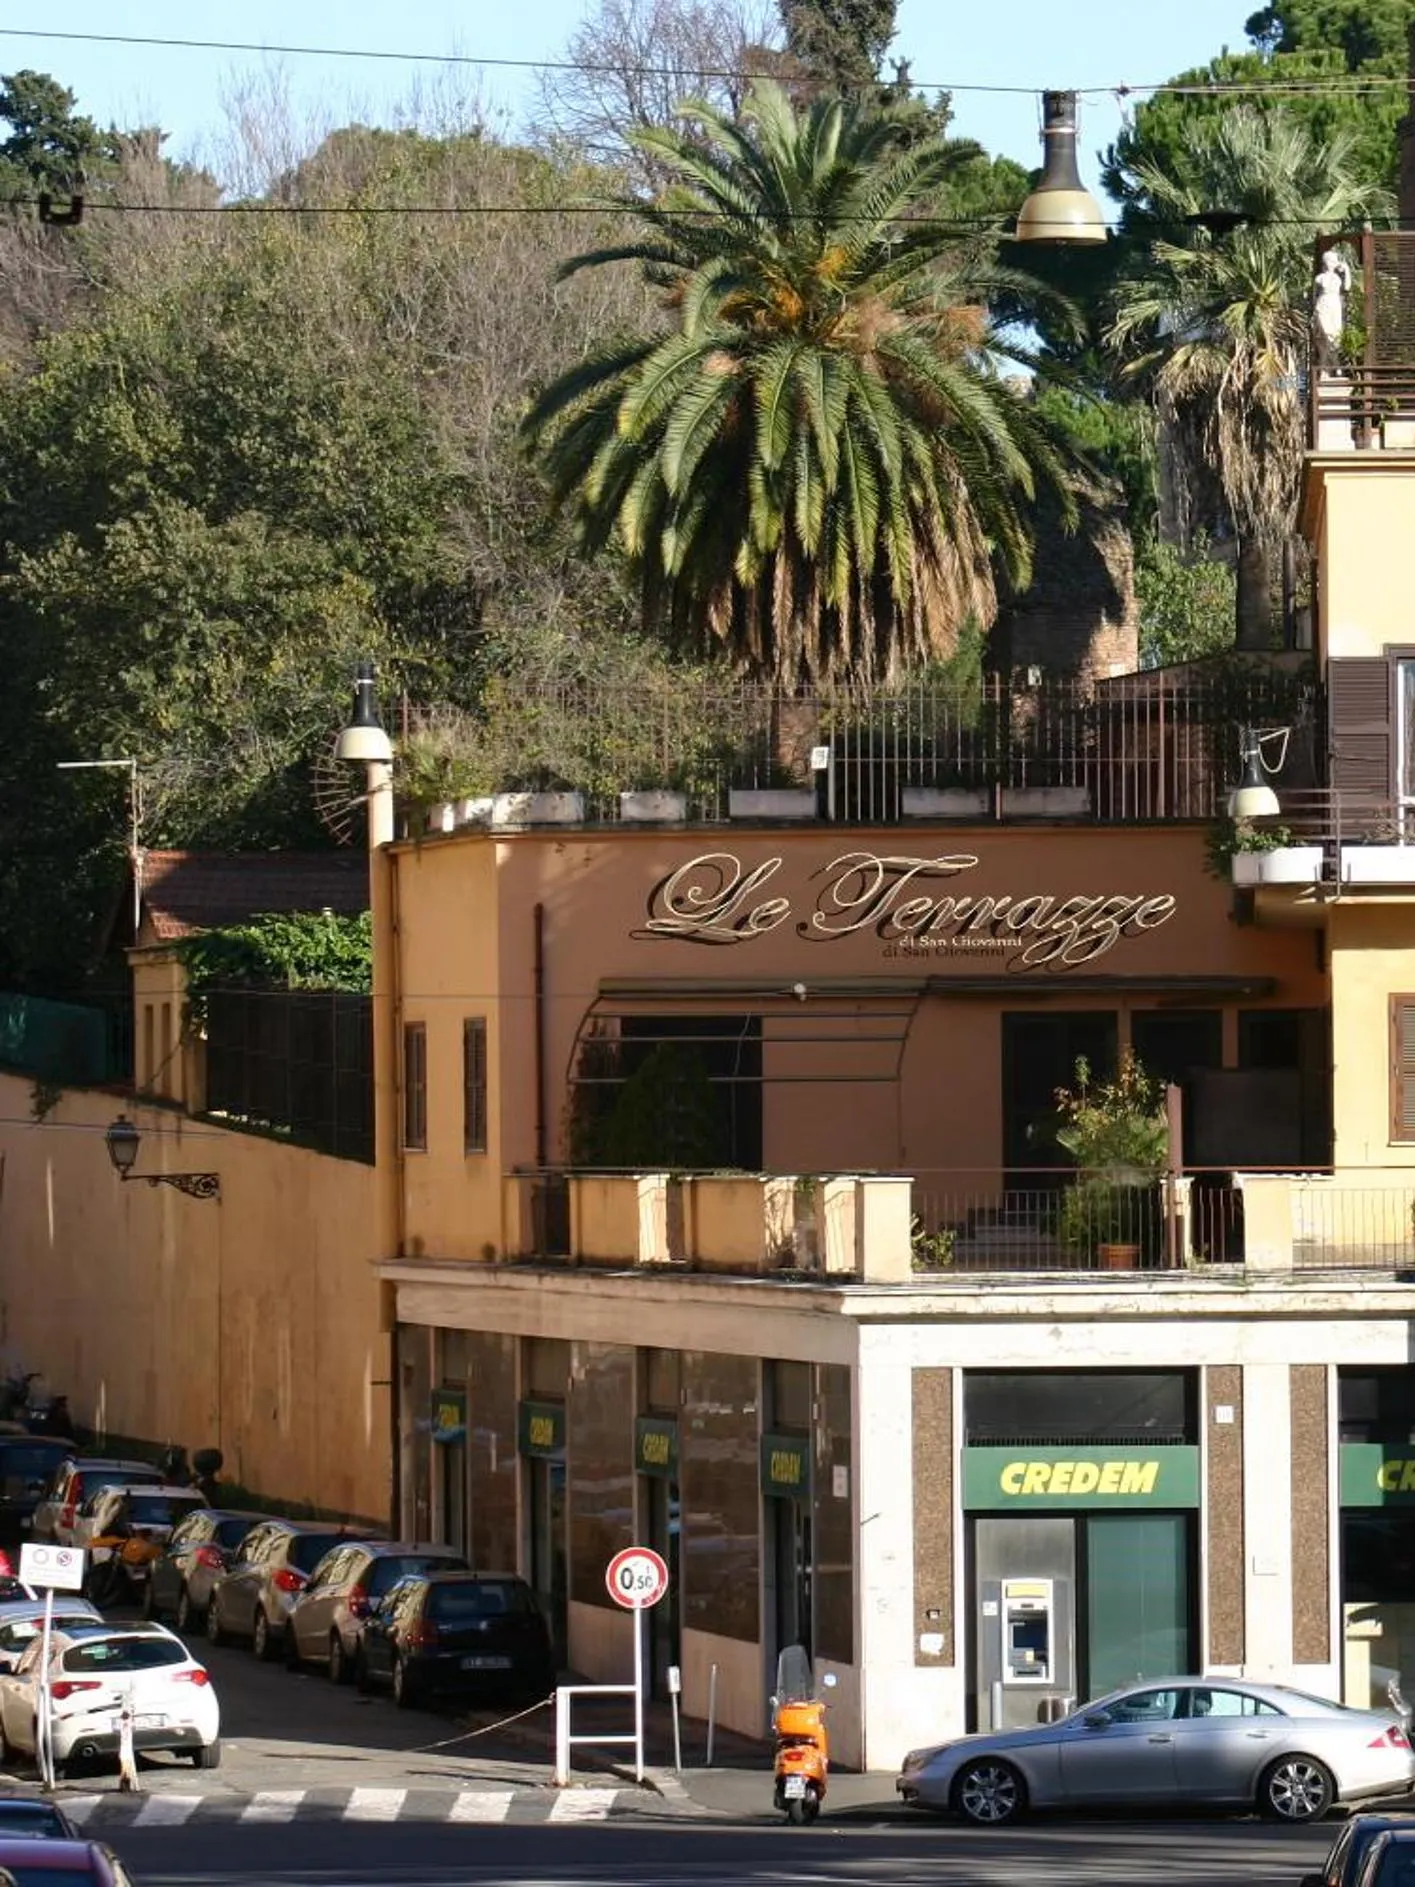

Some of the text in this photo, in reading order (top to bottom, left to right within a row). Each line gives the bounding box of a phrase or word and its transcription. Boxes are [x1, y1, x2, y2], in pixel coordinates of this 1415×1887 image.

[646, 852, 1176, 964] Le Terrazze
[899, 935, 1022, 947] di San Giovanni
[1001, 1461, 1160, 1495] CREDEM
